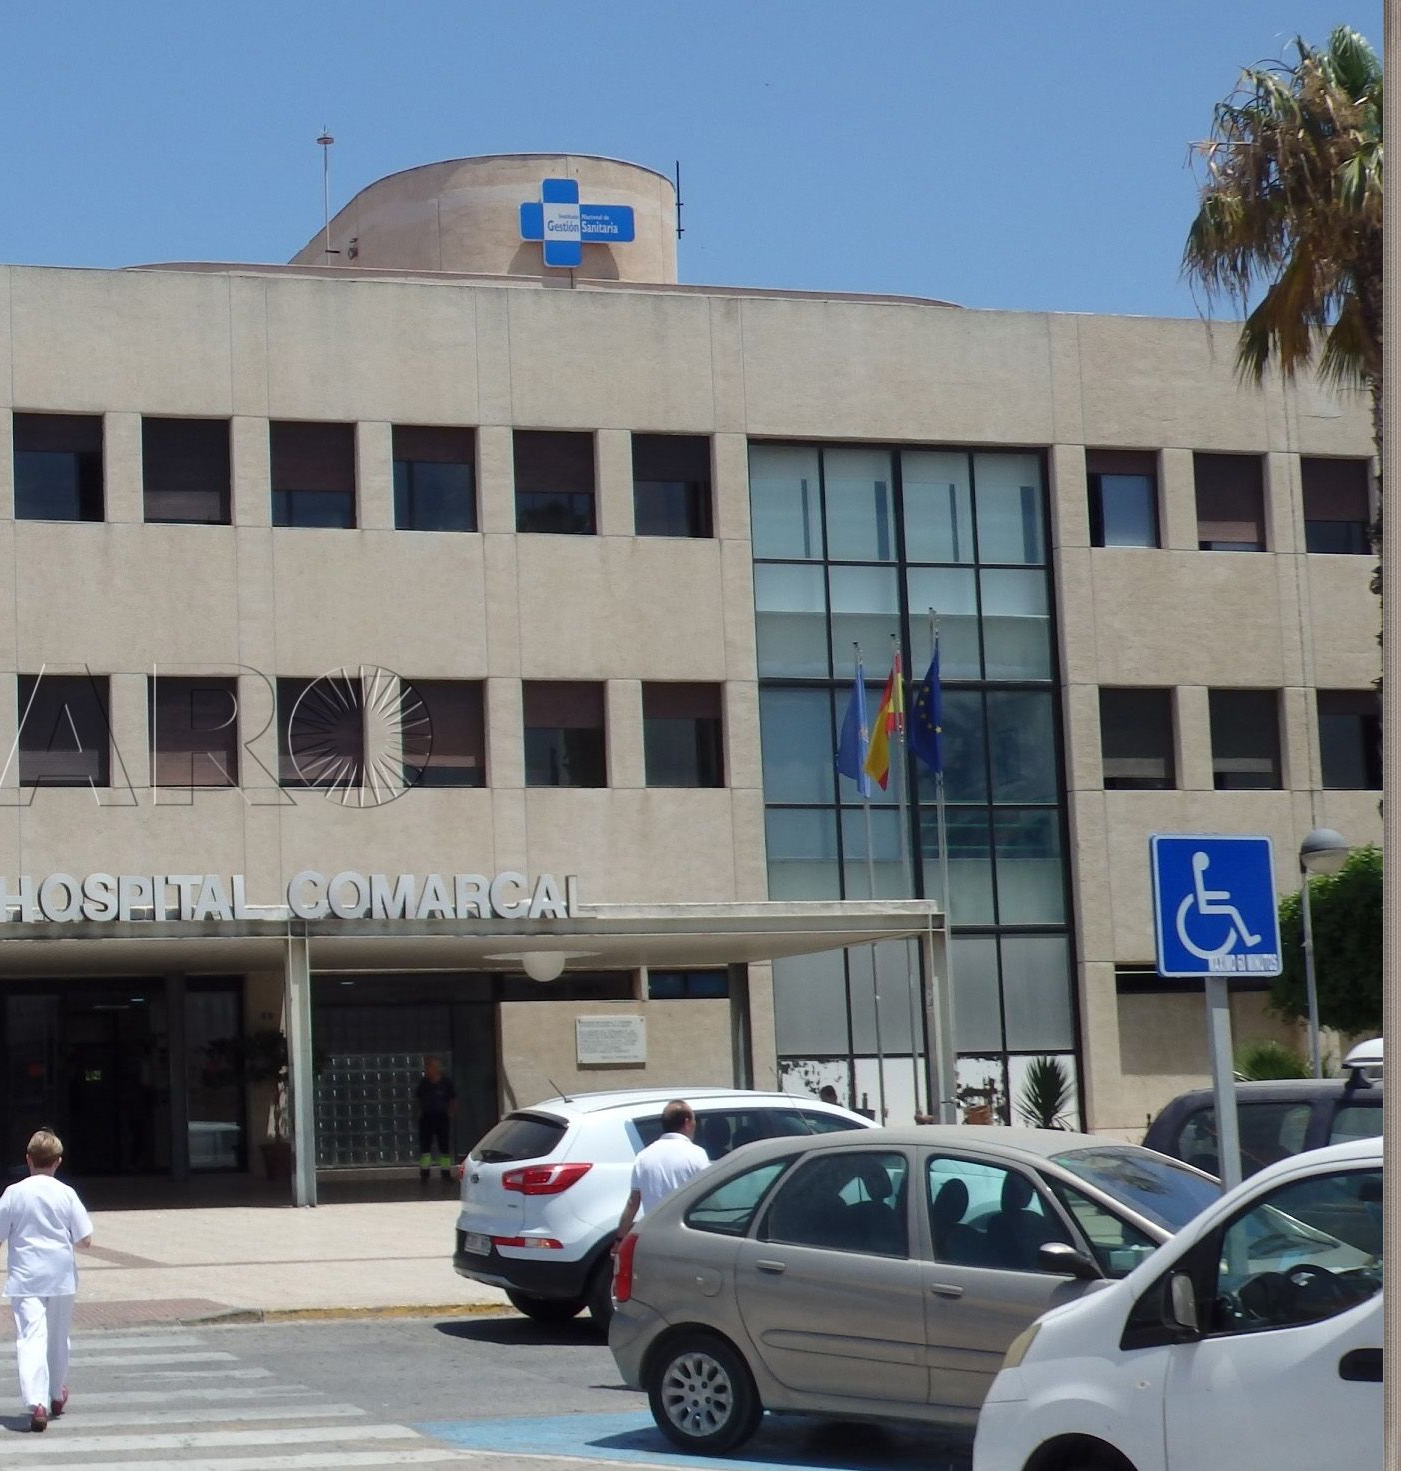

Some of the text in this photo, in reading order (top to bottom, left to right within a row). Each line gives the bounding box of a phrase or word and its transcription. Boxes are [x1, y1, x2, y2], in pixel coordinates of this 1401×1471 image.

[547, 219, 619, 234] Gestión Sanitaria
[287, 870, 595, 921] COMARCAL
